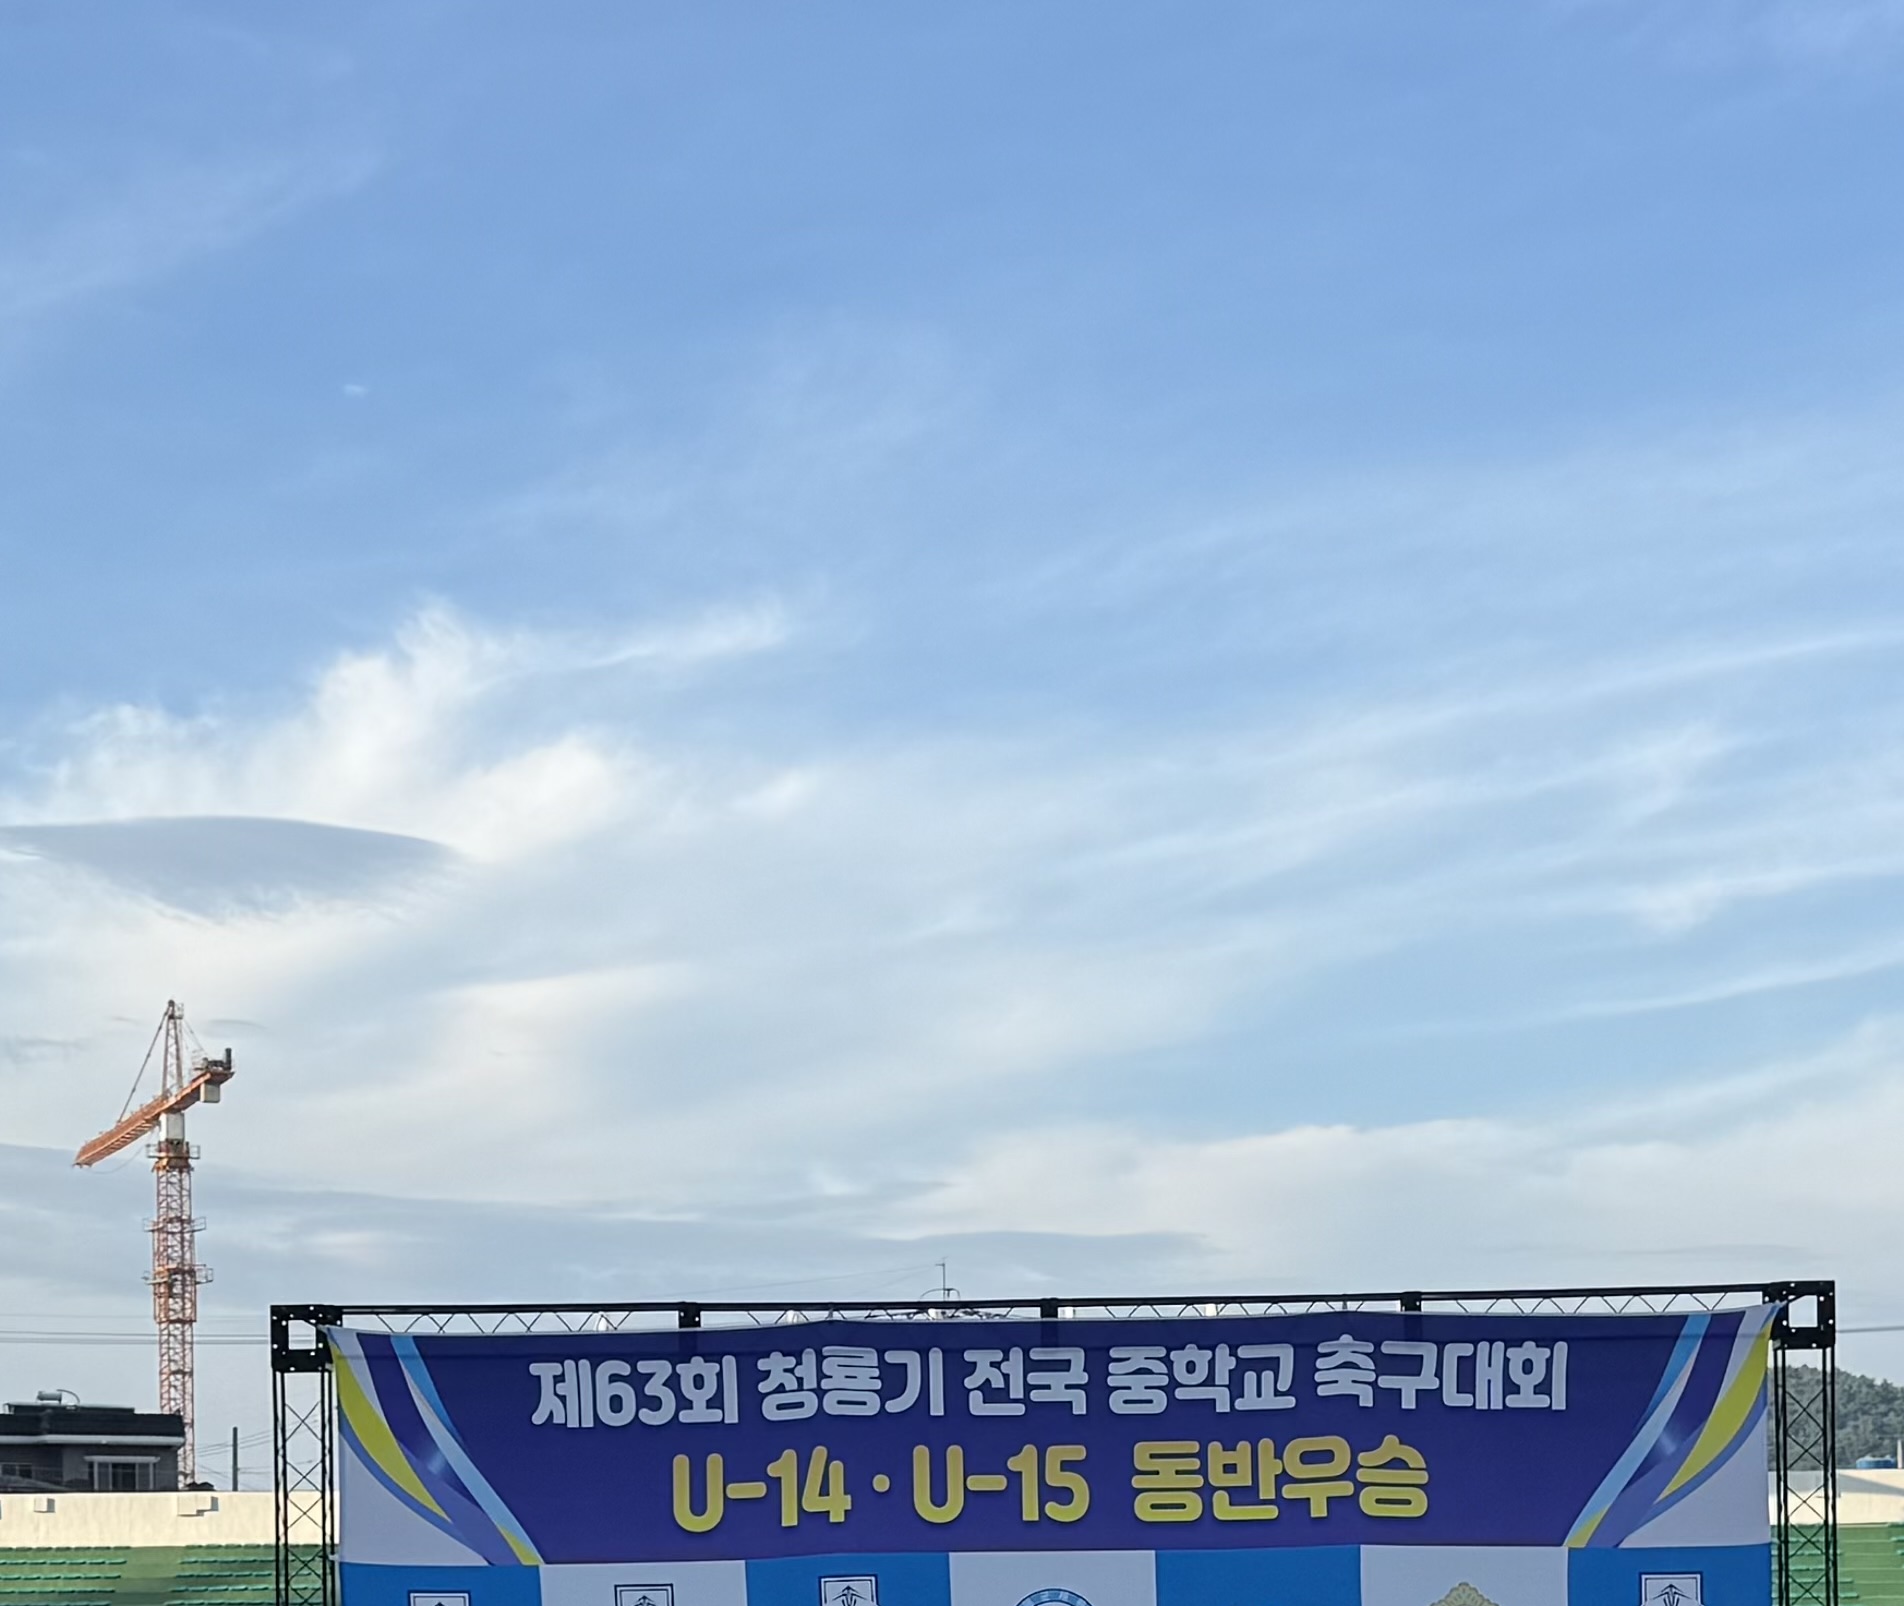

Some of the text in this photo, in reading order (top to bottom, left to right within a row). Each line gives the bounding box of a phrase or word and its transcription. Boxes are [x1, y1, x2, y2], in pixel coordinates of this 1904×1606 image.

[530, 1334, 1568, 1428] 제63회 청룡기 전국 중학교 축구대회
[1132, 1434, 1429, 1523] 동반우승
